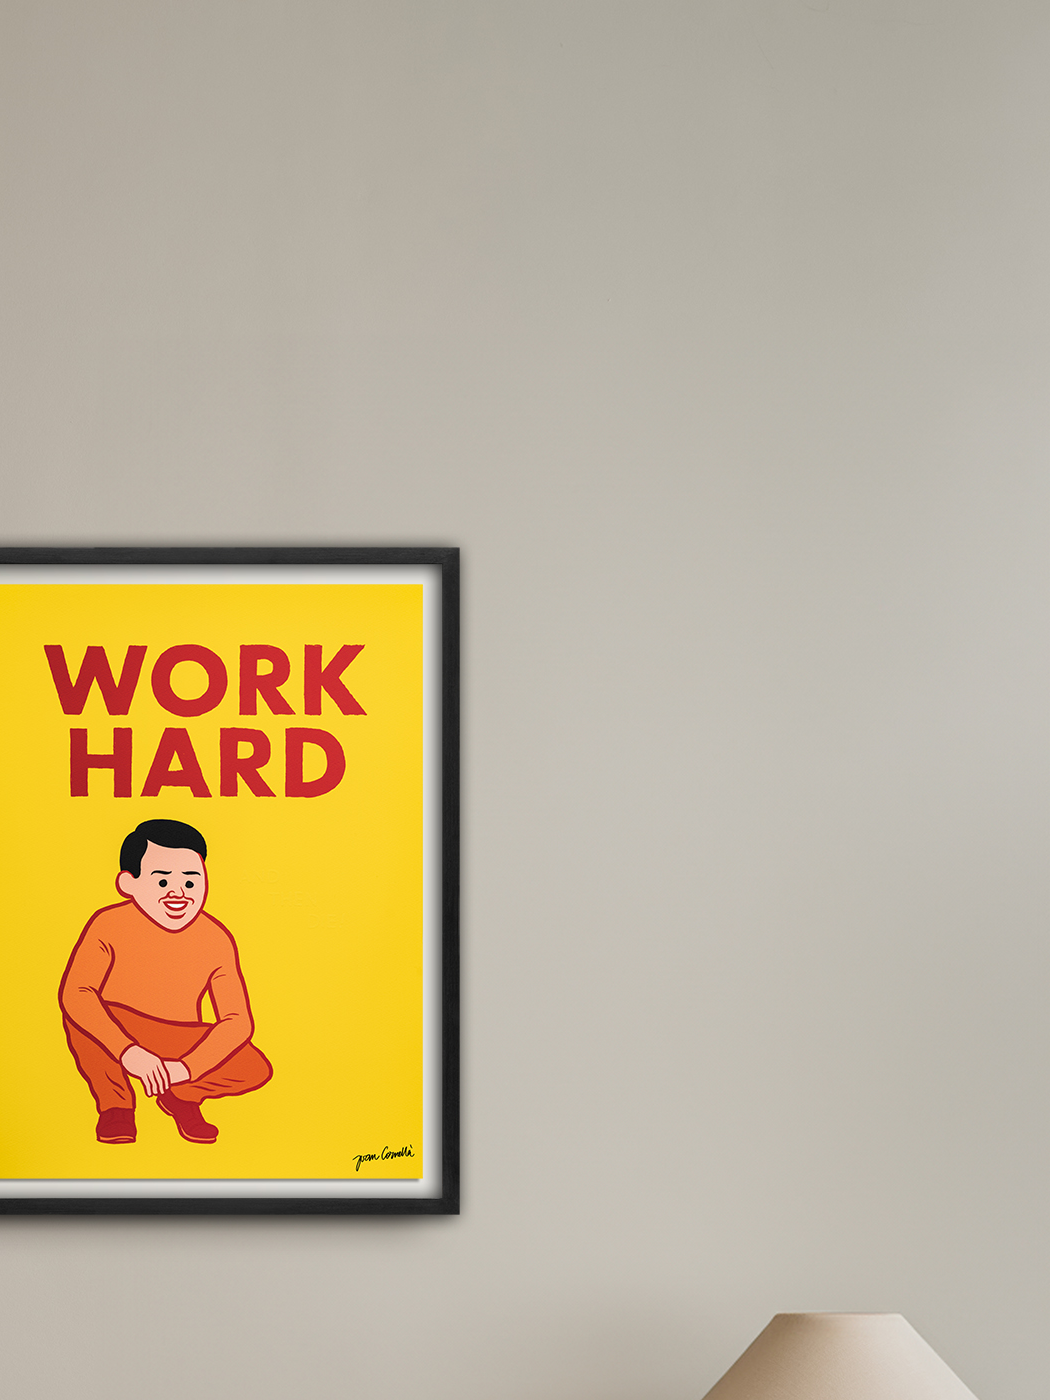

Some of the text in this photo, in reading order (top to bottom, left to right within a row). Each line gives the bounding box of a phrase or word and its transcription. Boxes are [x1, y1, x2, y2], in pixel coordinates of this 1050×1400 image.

[44, 645, 367, 717] WORK
[70, 727, 345, 798] HARD
[239, 868, 281, 885] AND
[267, 891, 318, 908] THEN
